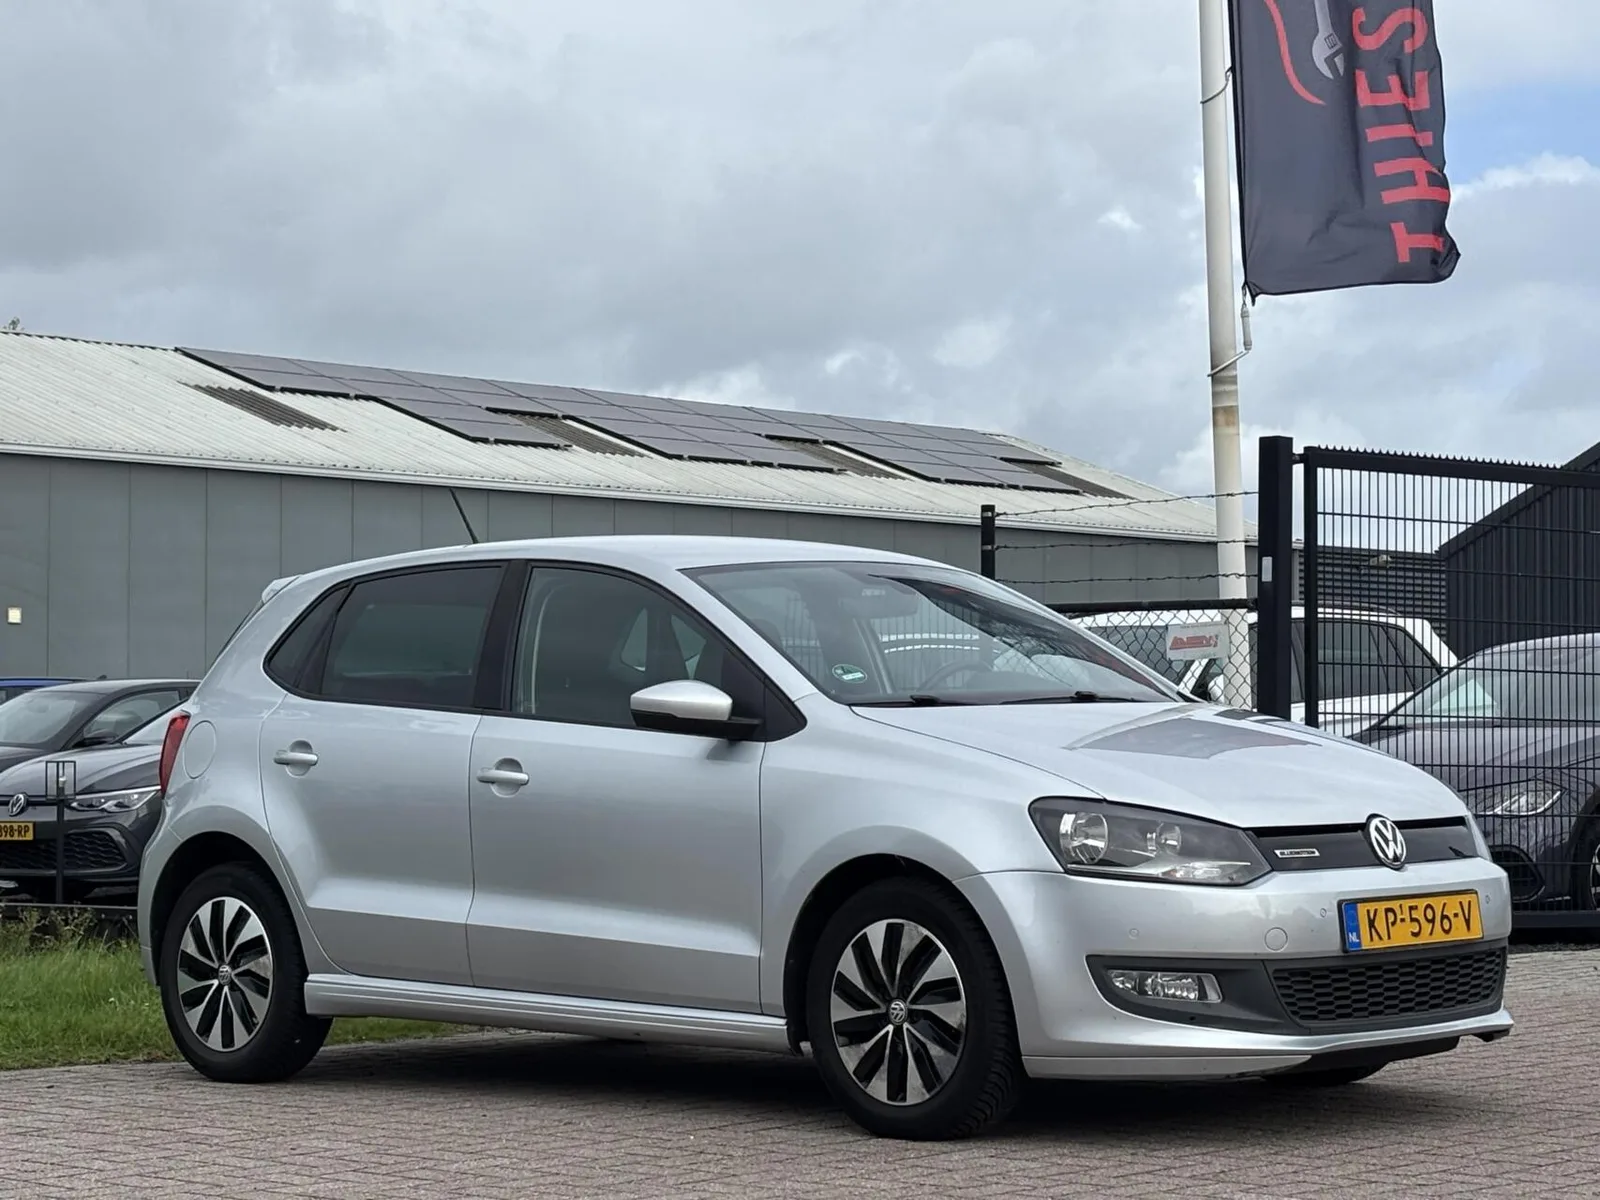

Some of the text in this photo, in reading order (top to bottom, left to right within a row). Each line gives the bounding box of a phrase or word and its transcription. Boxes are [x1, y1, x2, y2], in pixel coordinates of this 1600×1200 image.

[1352, 7, 1450, 263] THIES
[1369, 816, 1407, 866] VW
[1348, 931, 1360, 943] NL
[1366, 900, 1472, 942] KP-596-V
